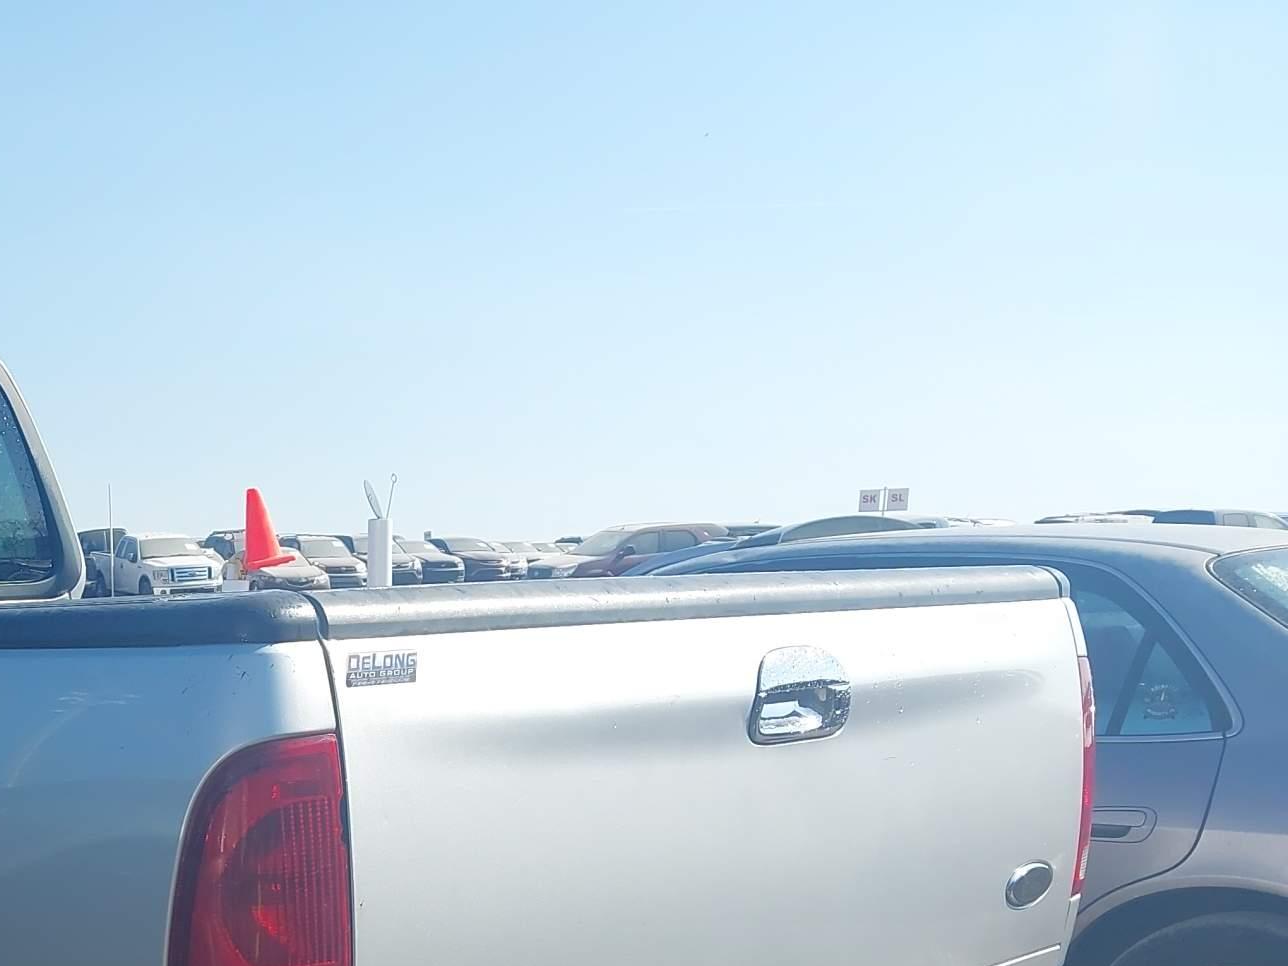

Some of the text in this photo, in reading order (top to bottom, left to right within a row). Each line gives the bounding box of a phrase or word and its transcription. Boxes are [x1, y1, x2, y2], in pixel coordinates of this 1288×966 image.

[862, 494, 877, 504] SK
[891, 493, 905, 503] SL
[349, 668, 414, 679] AUTO GROUP
